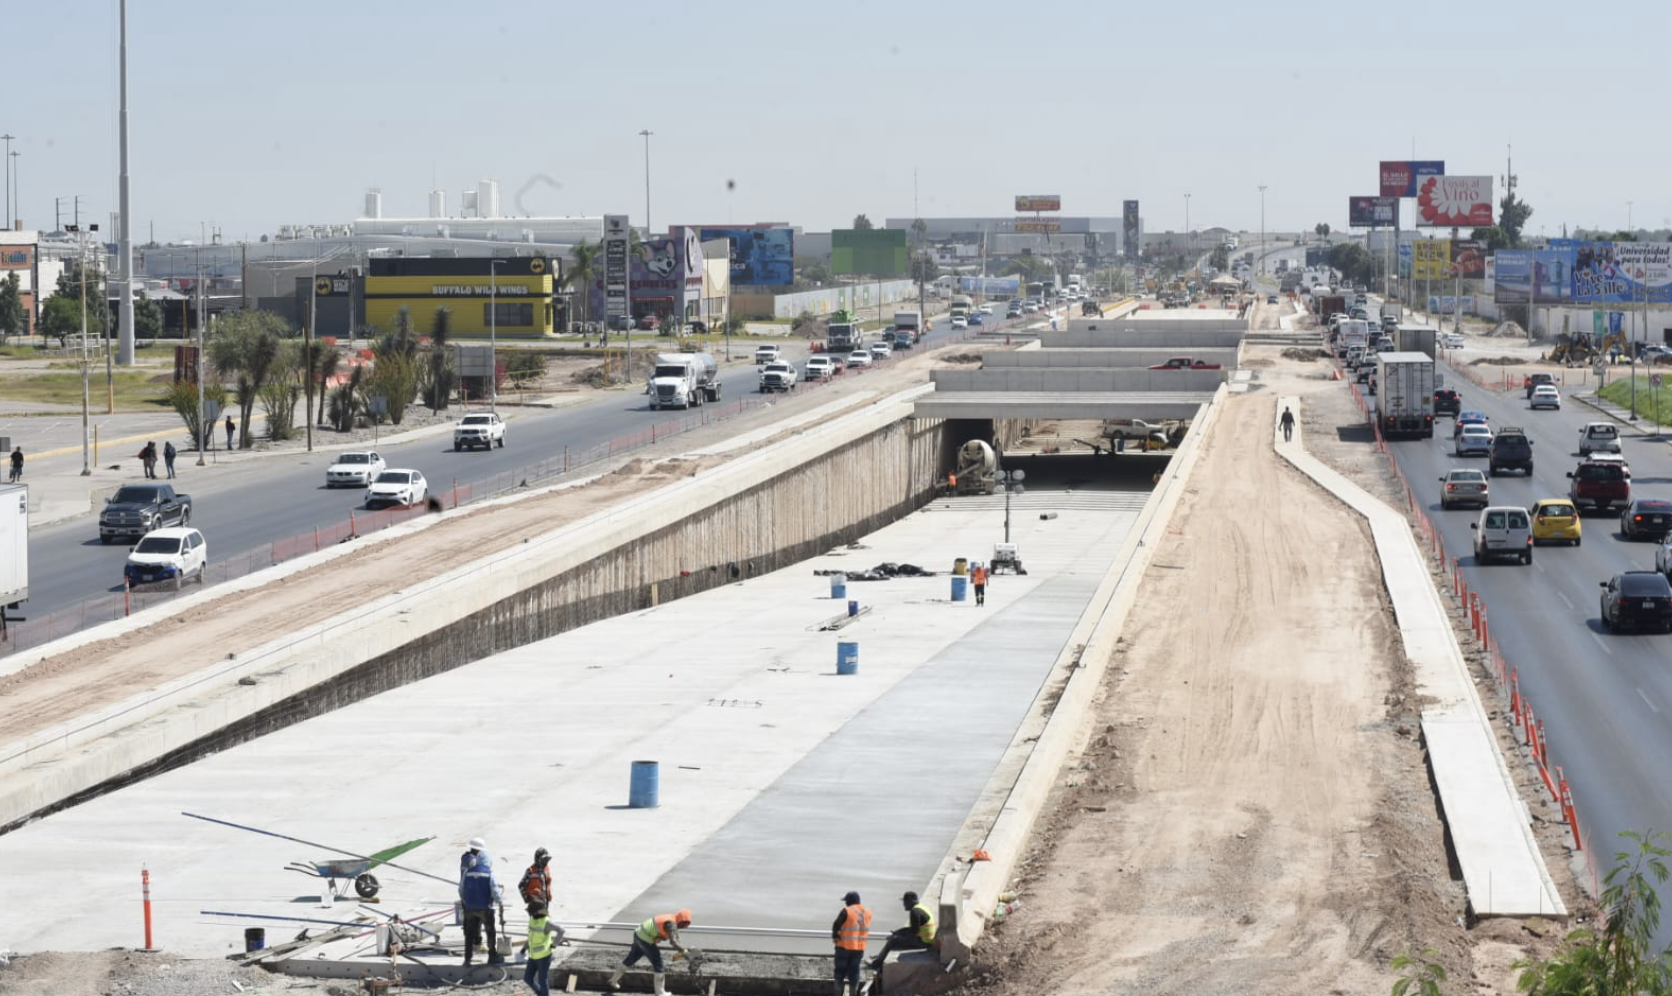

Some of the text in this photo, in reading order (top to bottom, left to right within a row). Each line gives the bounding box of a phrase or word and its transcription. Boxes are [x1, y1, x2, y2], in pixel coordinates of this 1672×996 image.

[1443, 178, 1479, 188] Festival
[1443, 188, 1480, 201] Vino
[1621, 256, 1641, 264] para
[432, 286, 529, 295] BUFFALO WILD WINGS
[1577, 283, 1592, 297] La
